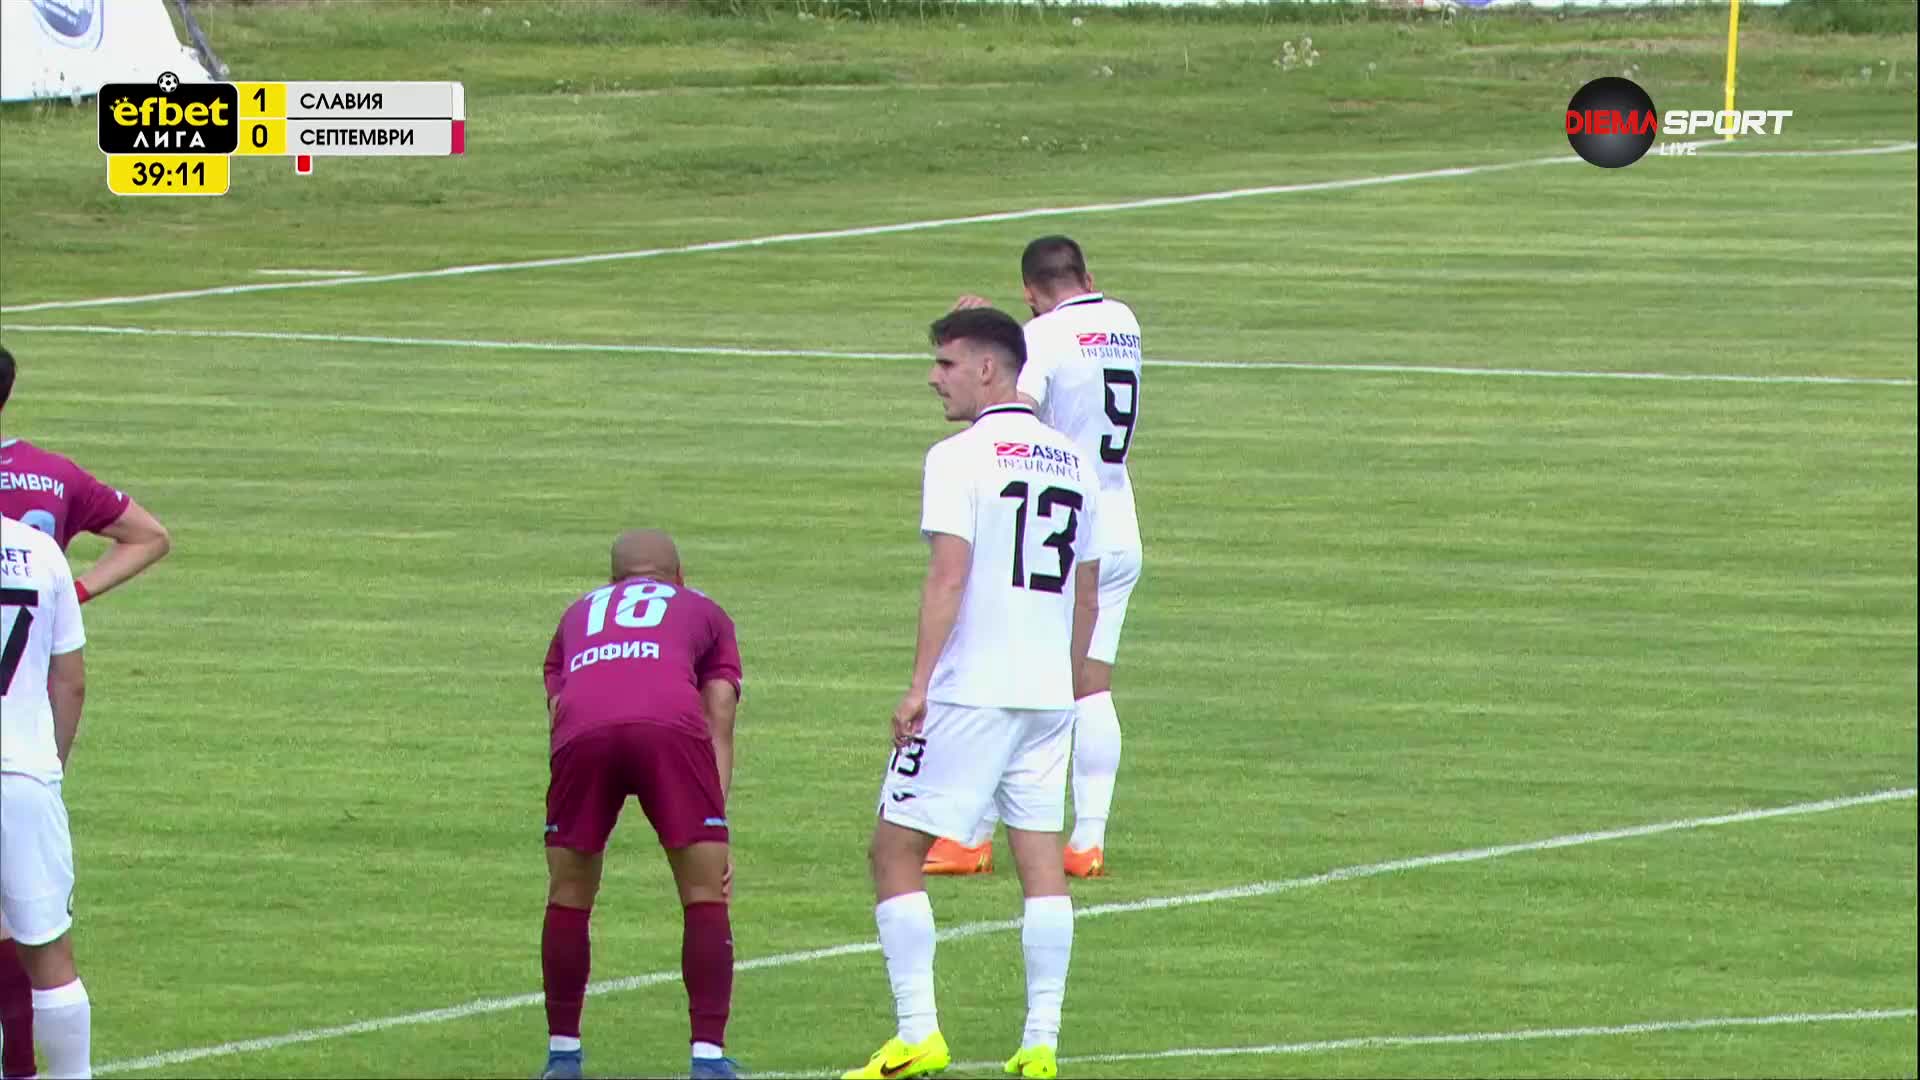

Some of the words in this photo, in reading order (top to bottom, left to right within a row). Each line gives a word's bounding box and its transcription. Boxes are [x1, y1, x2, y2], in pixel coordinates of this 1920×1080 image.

[1099, 367, 1138, 464] 9
[1031, 444, 1080, 469] ASSET
[1000, 480, 1084, 595] 13
[584, 582, 677, 637] 18
[570, 640, 661, 673] СОФИЯ
